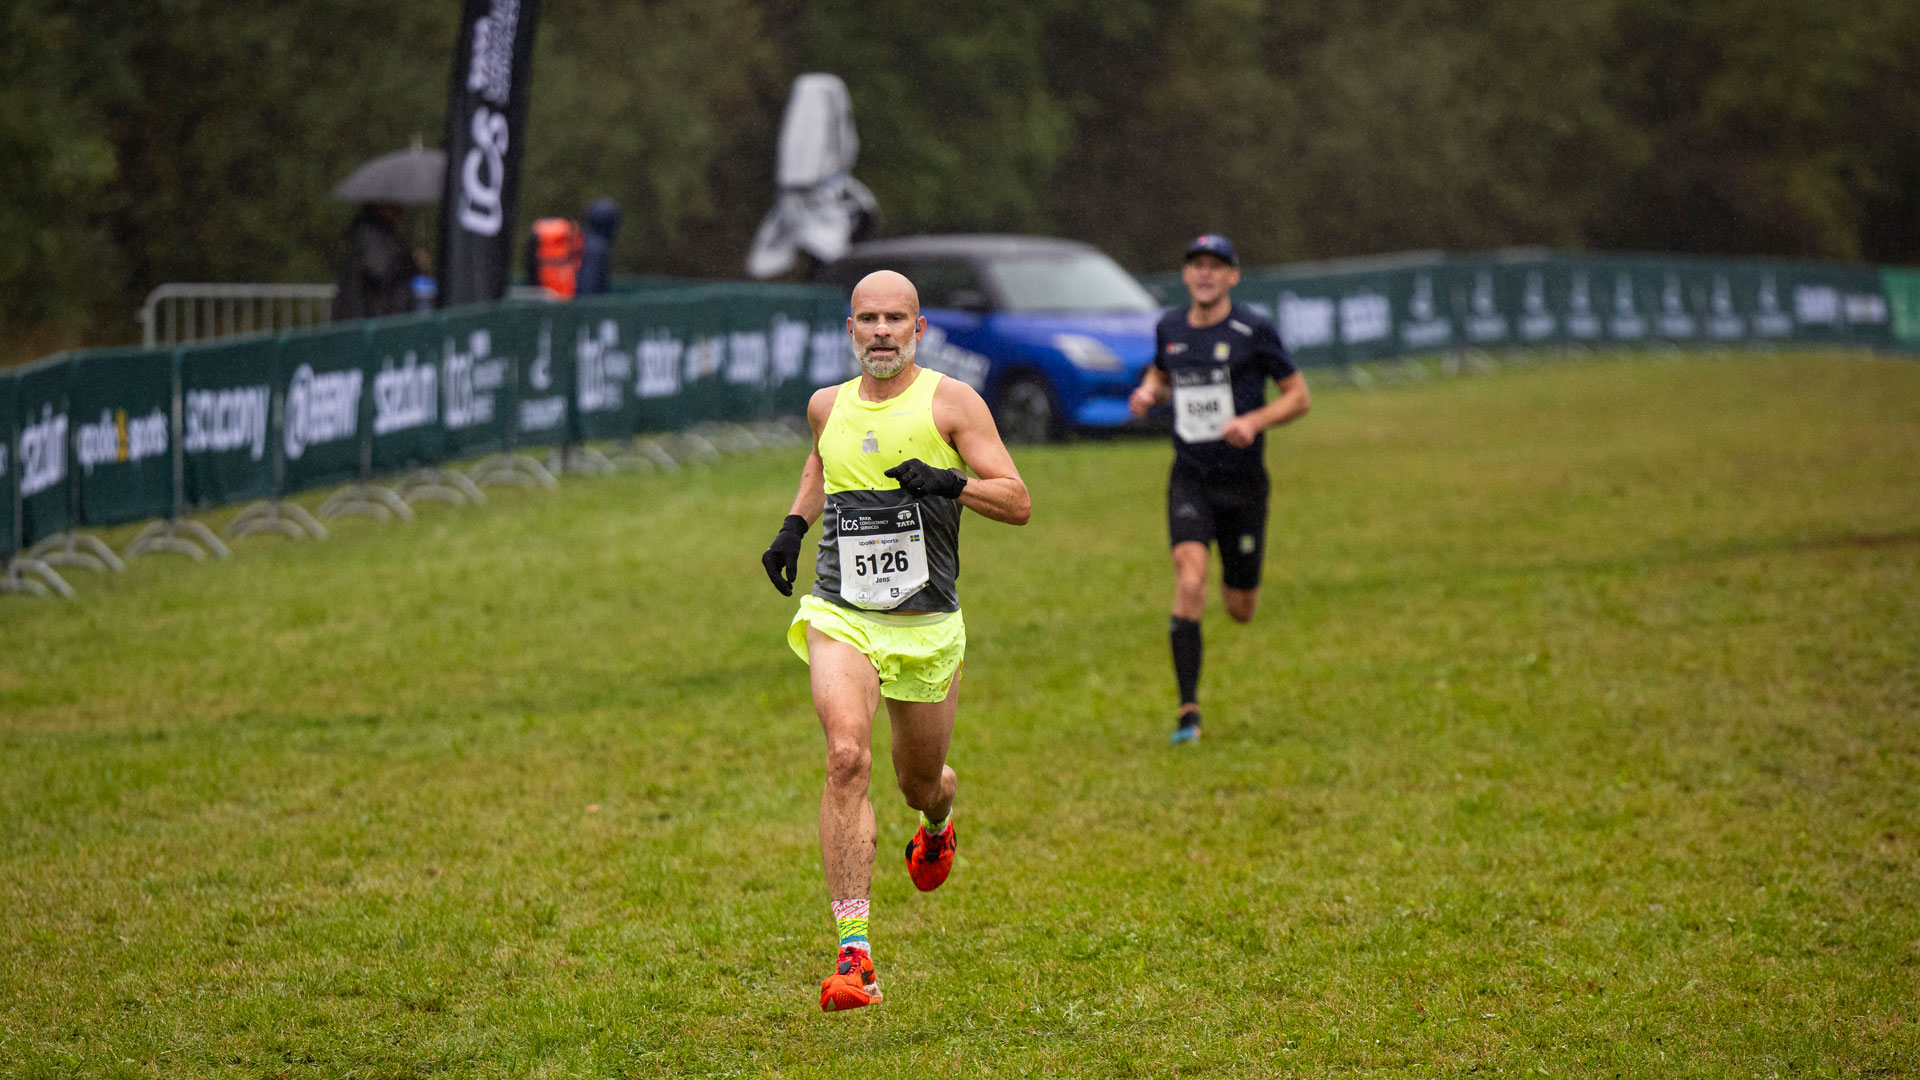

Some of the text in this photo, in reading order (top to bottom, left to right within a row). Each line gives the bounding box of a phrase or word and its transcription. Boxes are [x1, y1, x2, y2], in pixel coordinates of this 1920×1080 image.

[842, 517, 858, 530] tcs
[896, 520, 916, 528] TATA
[856, 550, 908, 576] 5126
